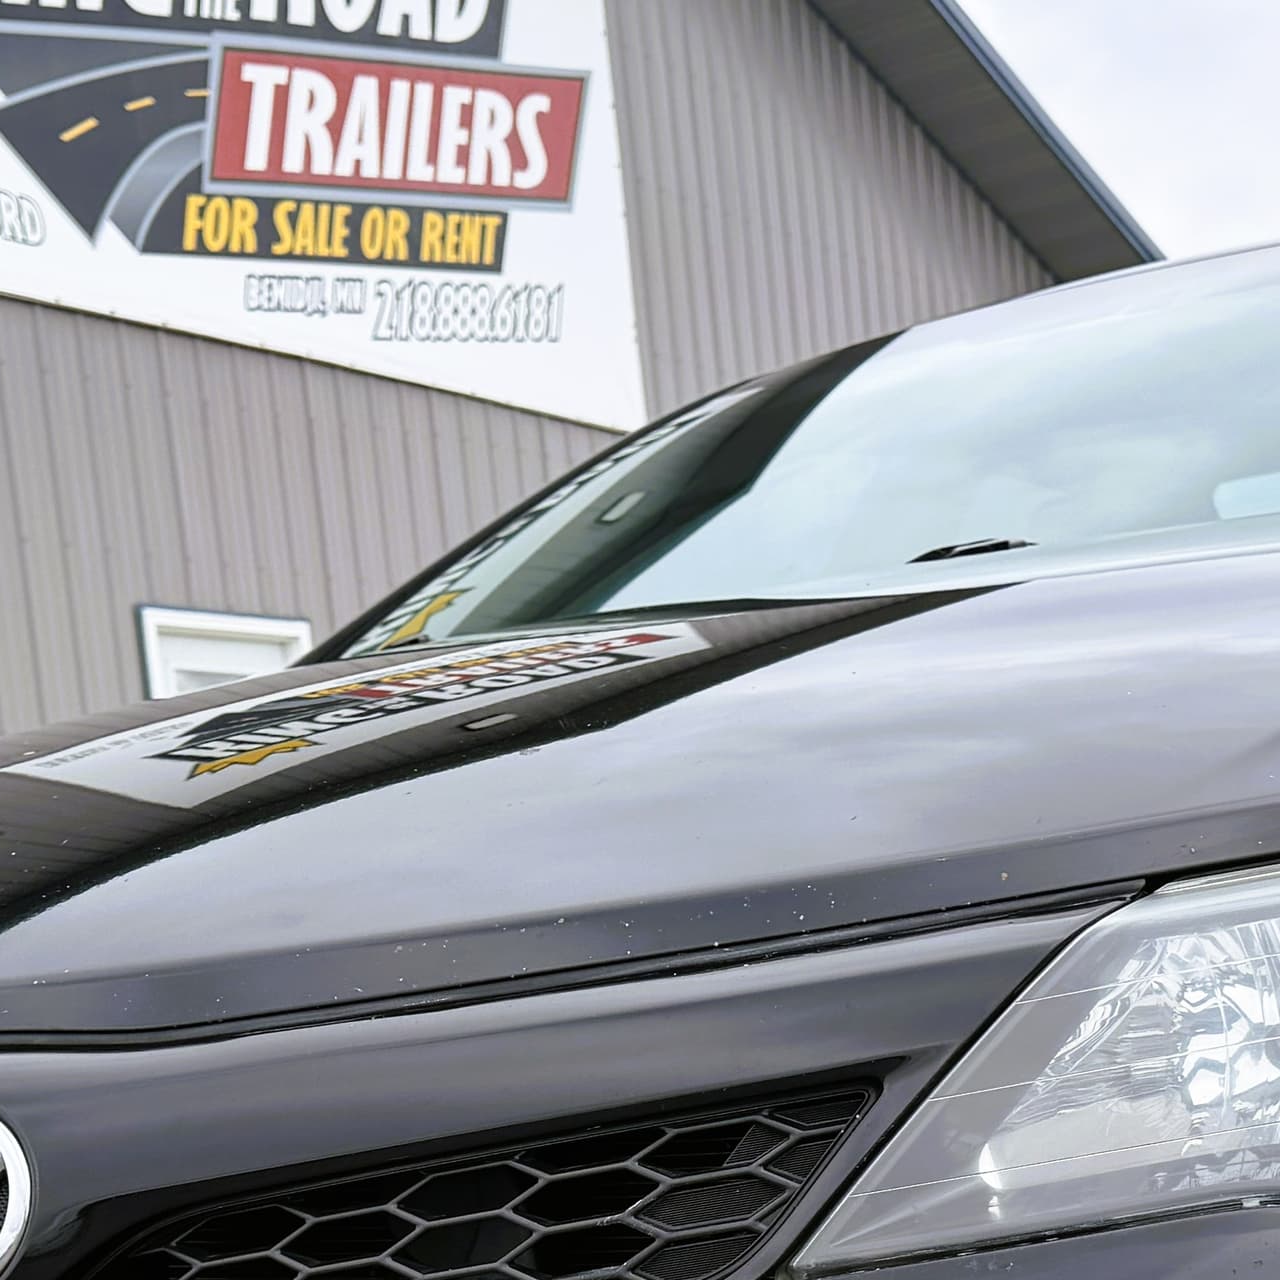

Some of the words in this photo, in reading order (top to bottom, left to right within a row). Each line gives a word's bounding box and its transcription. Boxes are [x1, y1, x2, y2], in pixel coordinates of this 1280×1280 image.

[240, 63, 552, 190] TRAILERS
[182, 194, 258, 253] FOR
[271, 200, 351, 257] SALE
[361, 208, 410, 260] OR
[421, 210, 502, 264] RENT
